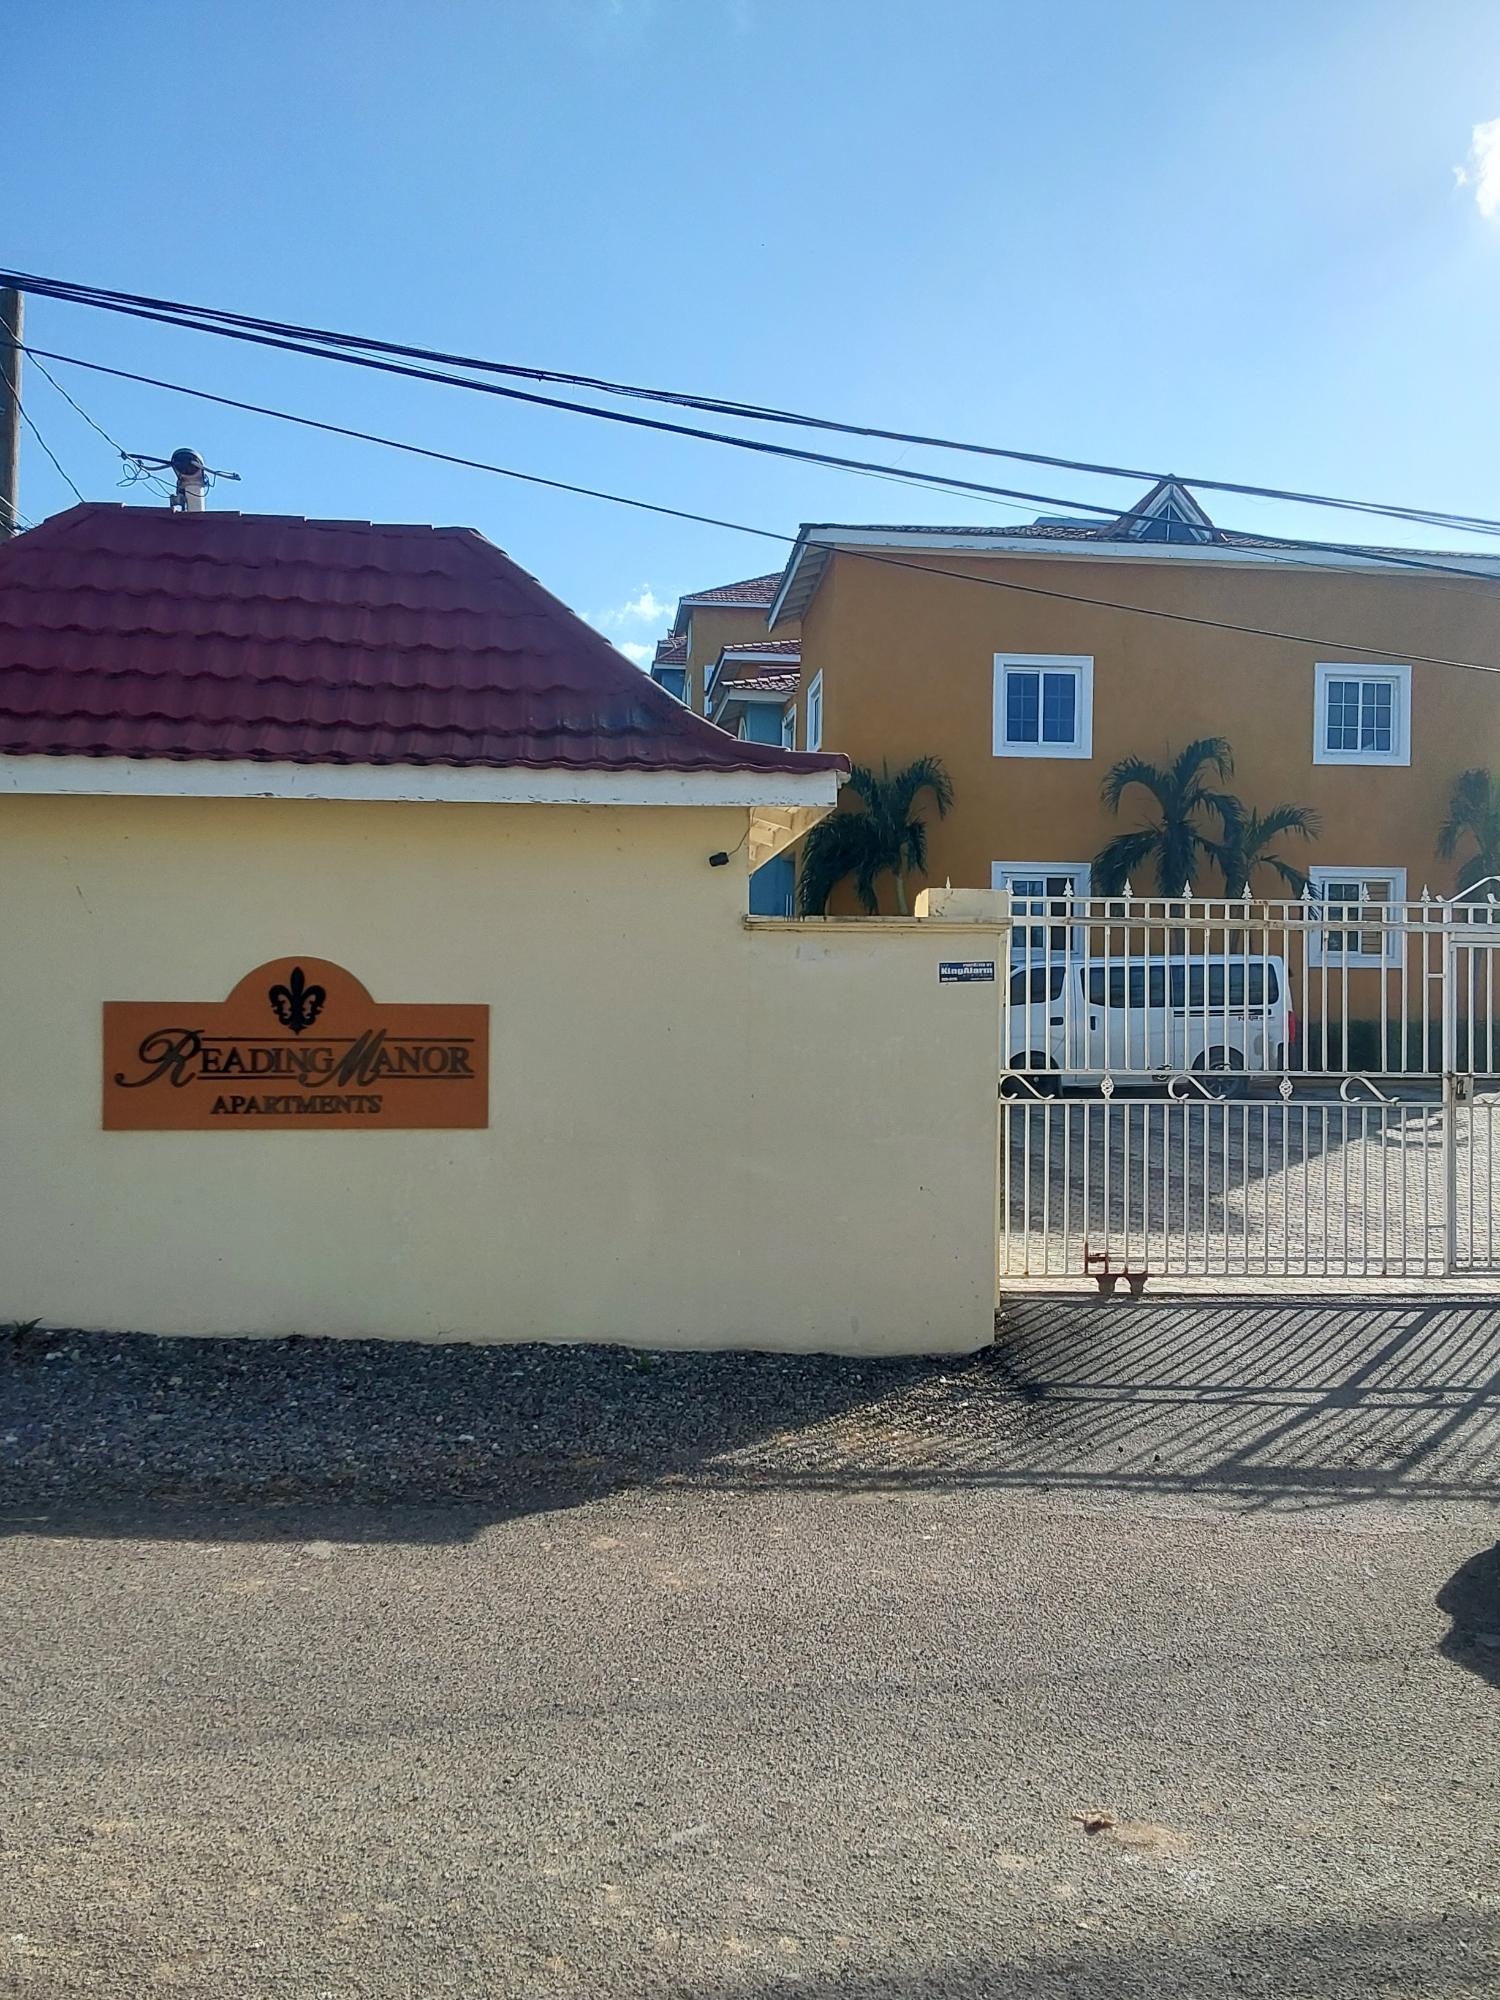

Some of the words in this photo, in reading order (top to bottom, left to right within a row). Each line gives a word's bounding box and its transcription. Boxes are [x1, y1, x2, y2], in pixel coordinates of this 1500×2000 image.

[941, 967, 993, 975] KingAlarm
[298, 1028, 474, 1088] MANOR
[210, 1095, 383, 1115] APARTMENTS
